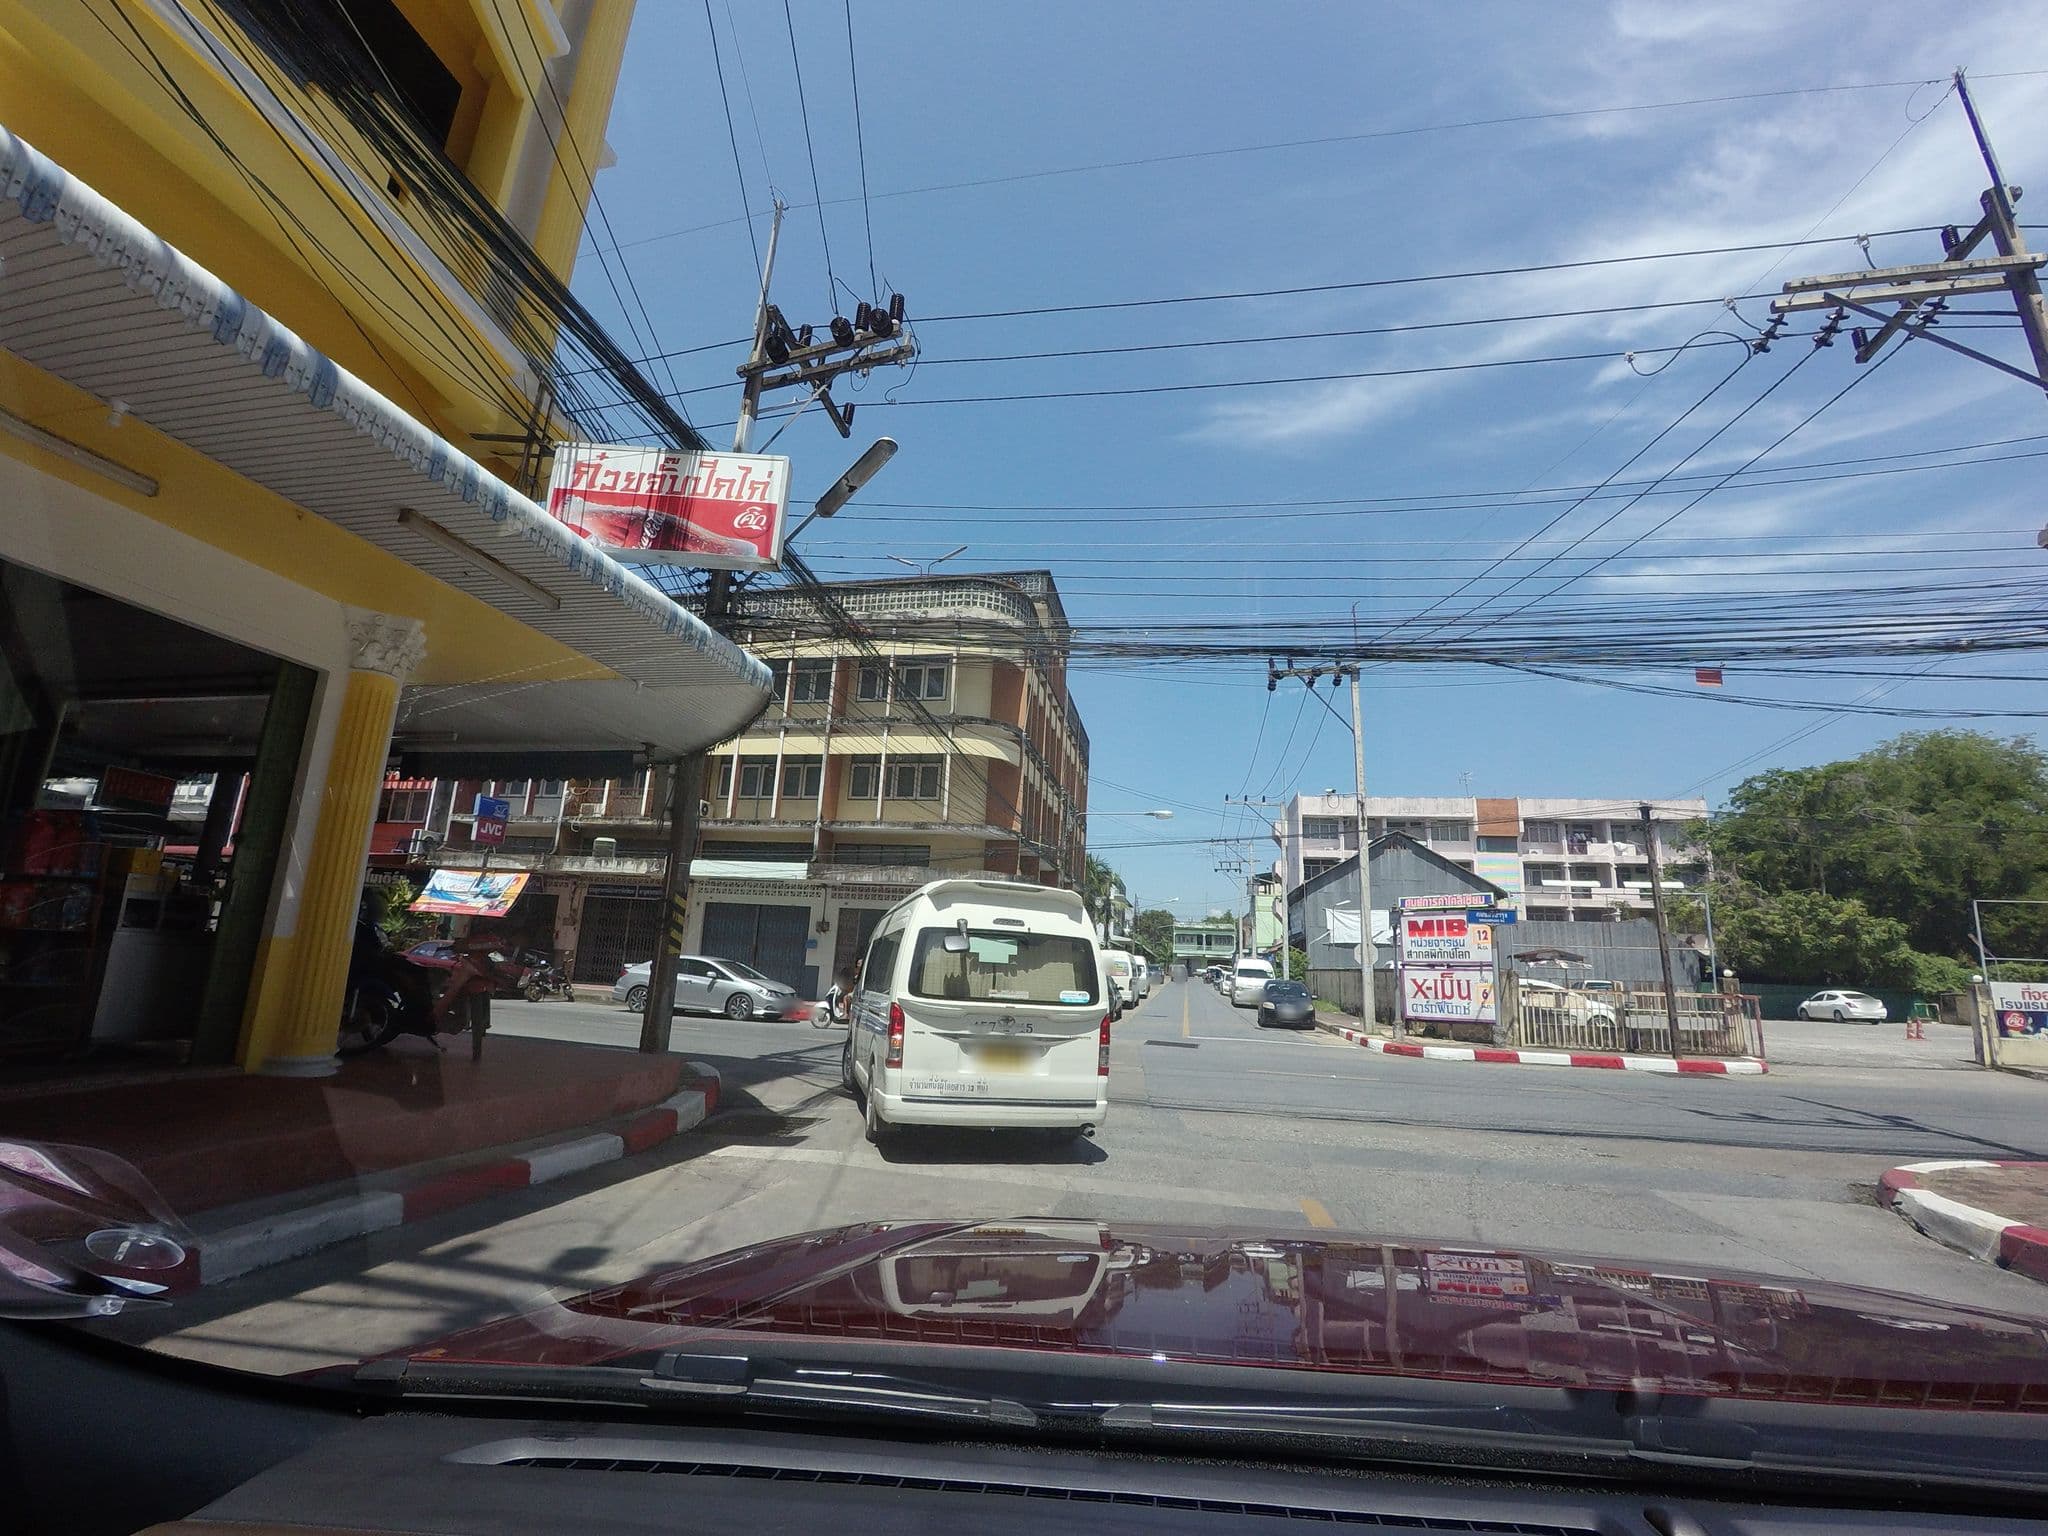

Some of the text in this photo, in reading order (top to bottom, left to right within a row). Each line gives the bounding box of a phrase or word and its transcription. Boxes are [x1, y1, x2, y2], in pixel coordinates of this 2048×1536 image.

[480, 822, 503, 836] JVC
[1407, 918, 1468, 937] MIB
[1477, 930, 1489, 941] 12
[1410, 972, 1473, 1001] X-เม็น
[1482, 988, 1489, 1000] 6
